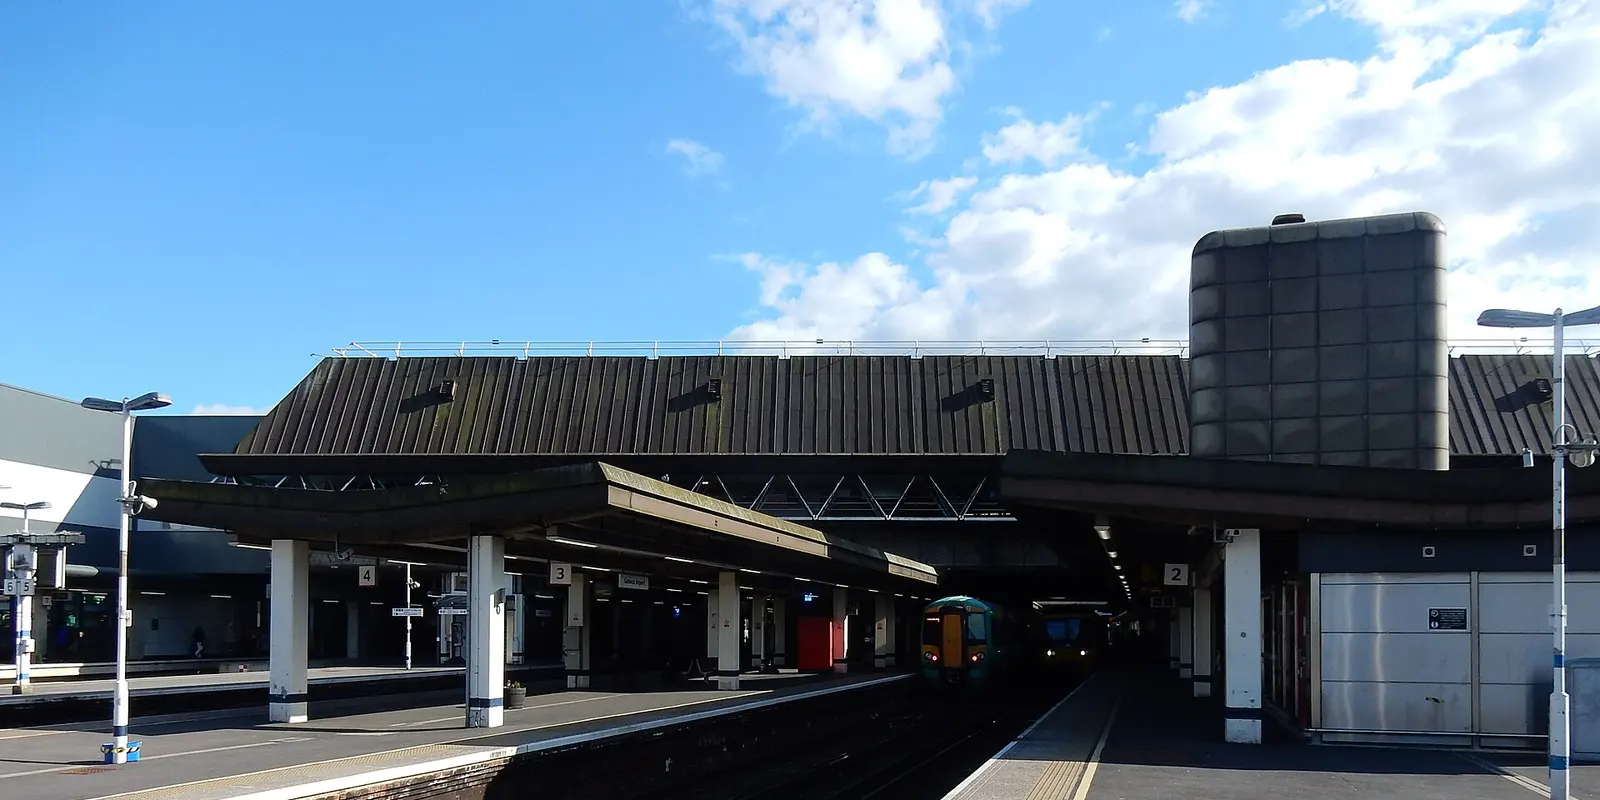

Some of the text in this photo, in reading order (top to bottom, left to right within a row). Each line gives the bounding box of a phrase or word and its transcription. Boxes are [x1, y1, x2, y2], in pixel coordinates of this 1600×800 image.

[363, 569, 371, 582] 4
[557, 567, 566, 580] 3
[1171, 567, 1182, 581] 2
[7, 582, 13, 592] 6
[24, 582, 30, 592] 5
